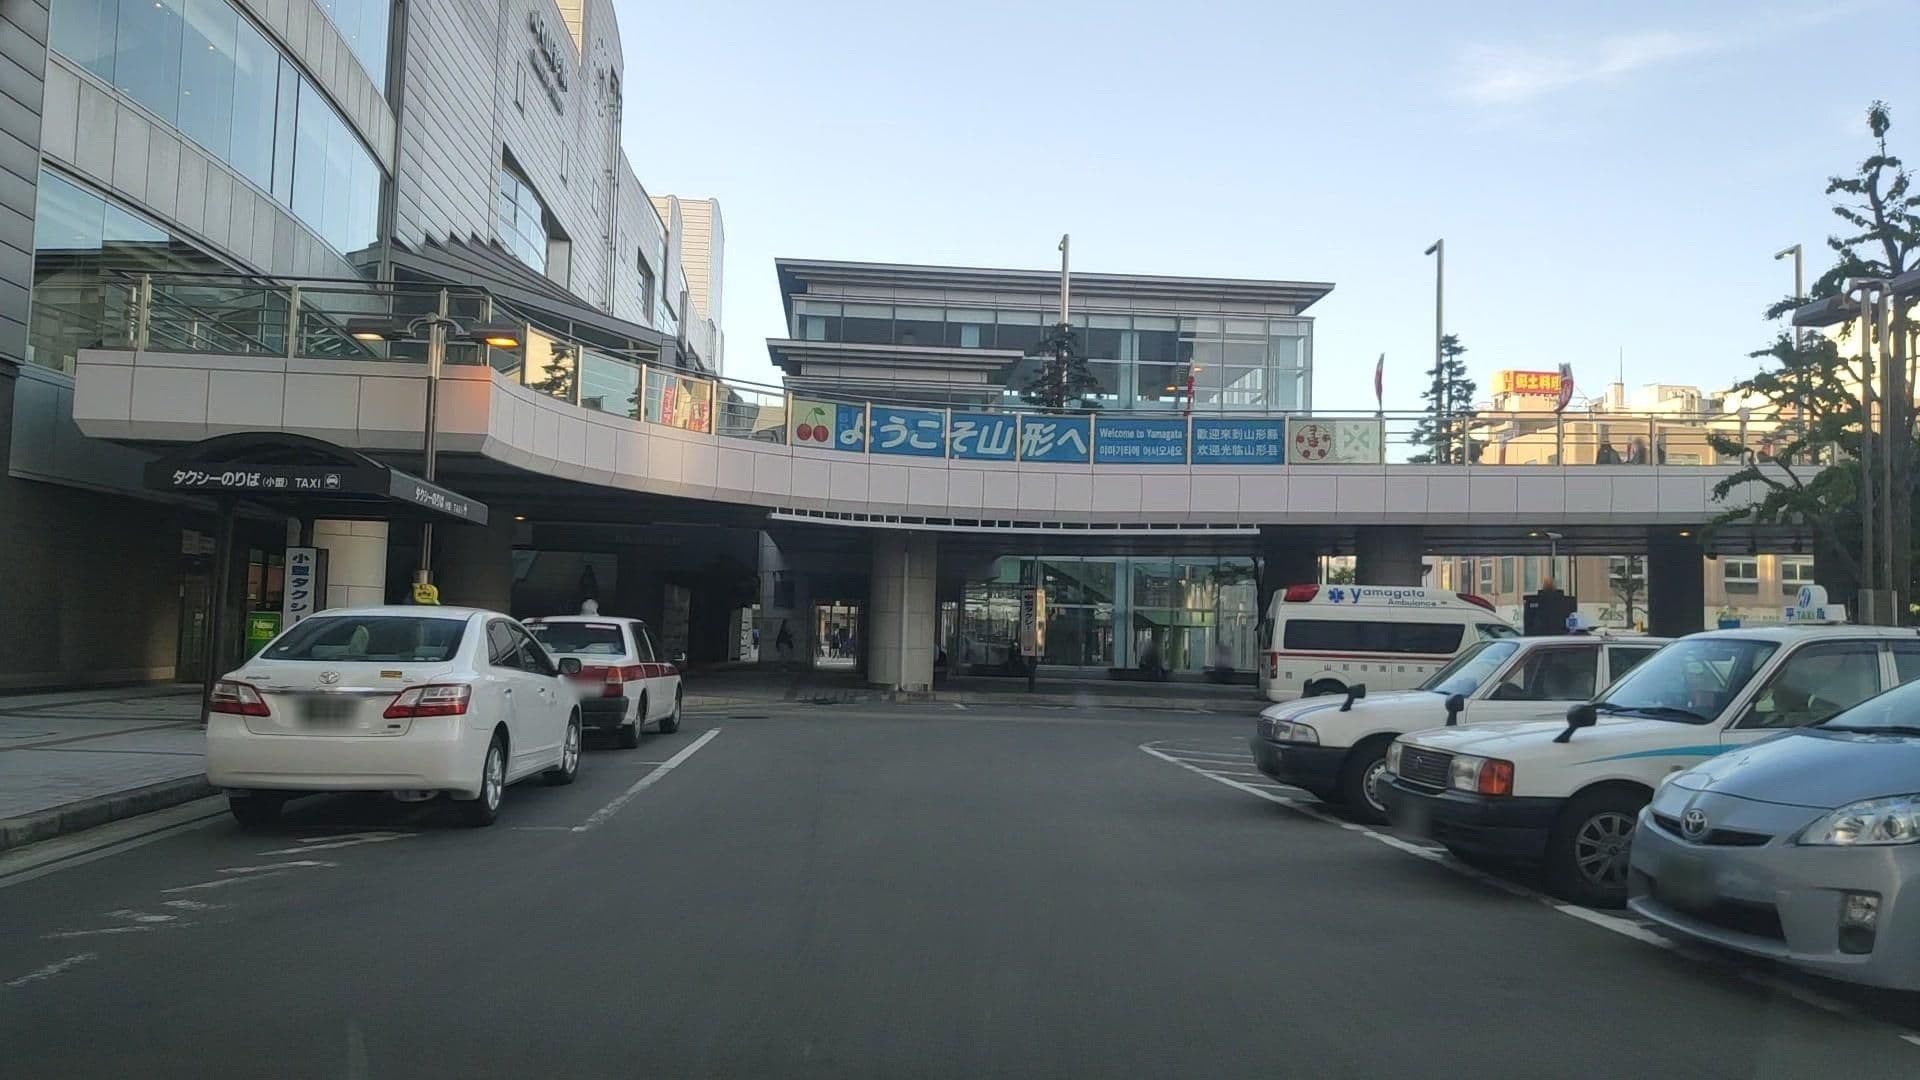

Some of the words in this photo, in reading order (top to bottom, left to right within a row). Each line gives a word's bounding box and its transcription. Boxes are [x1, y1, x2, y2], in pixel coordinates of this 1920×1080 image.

[840, 411, 1087, 457] ようこそ山形へ
[1099, 428, 1134, 439] Welcome
[1136, 429, 1145, 438] to
[1147, 429, 1183, 441] Yamagata
[173, 470, 261, 487] タクシーのりば
[295, 478, 321, 488] TAXI
[1387, 599, 1437, 607] Ambulance
